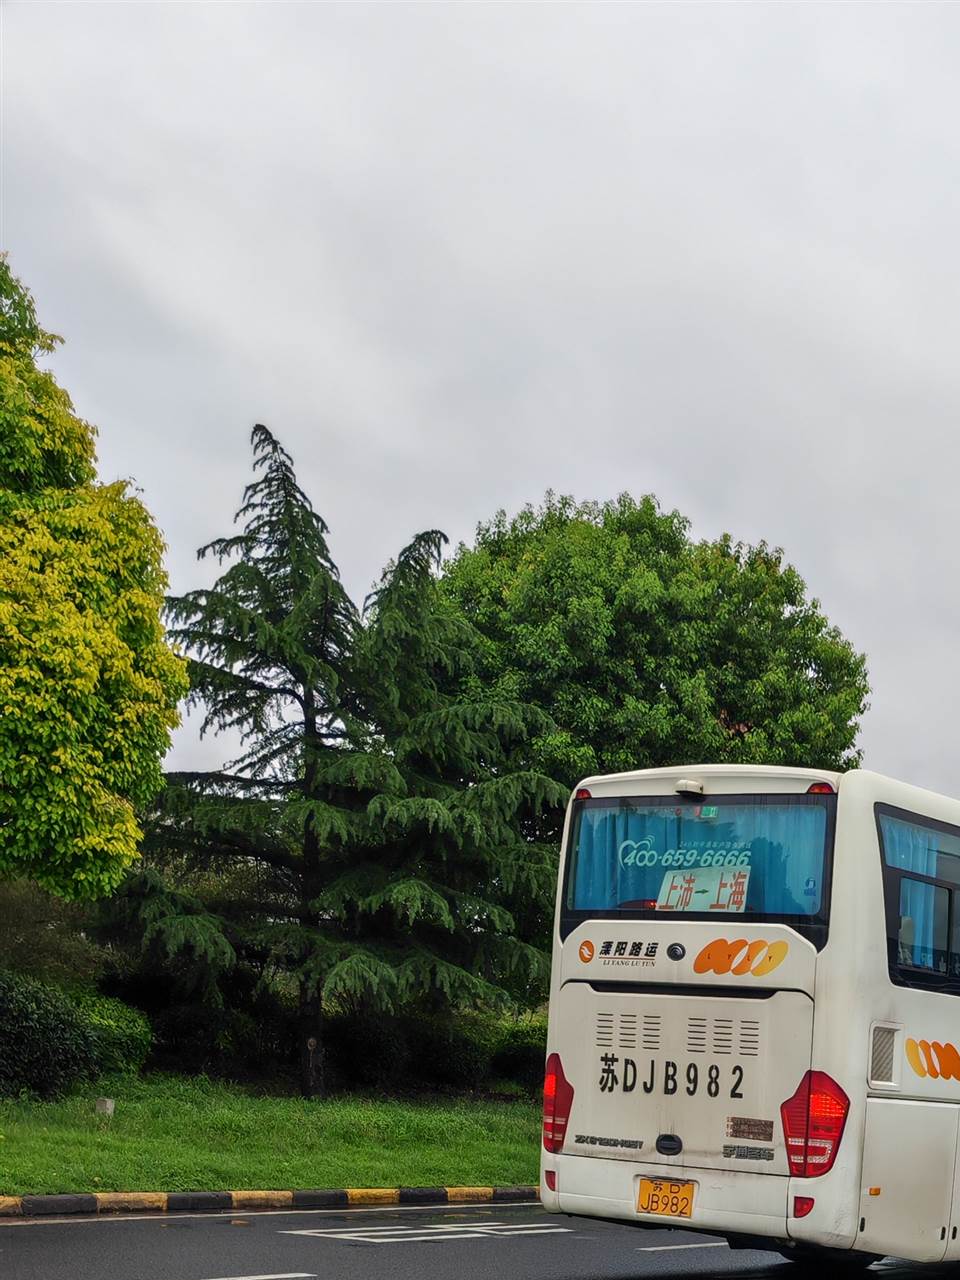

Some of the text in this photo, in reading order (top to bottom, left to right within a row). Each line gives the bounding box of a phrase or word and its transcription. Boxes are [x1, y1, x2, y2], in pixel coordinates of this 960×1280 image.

[709, 871, 747, 911] 上海
[599, 1052, 744, 1099] 苏DJB982
[640, 1193, 690, 1215] JB982
